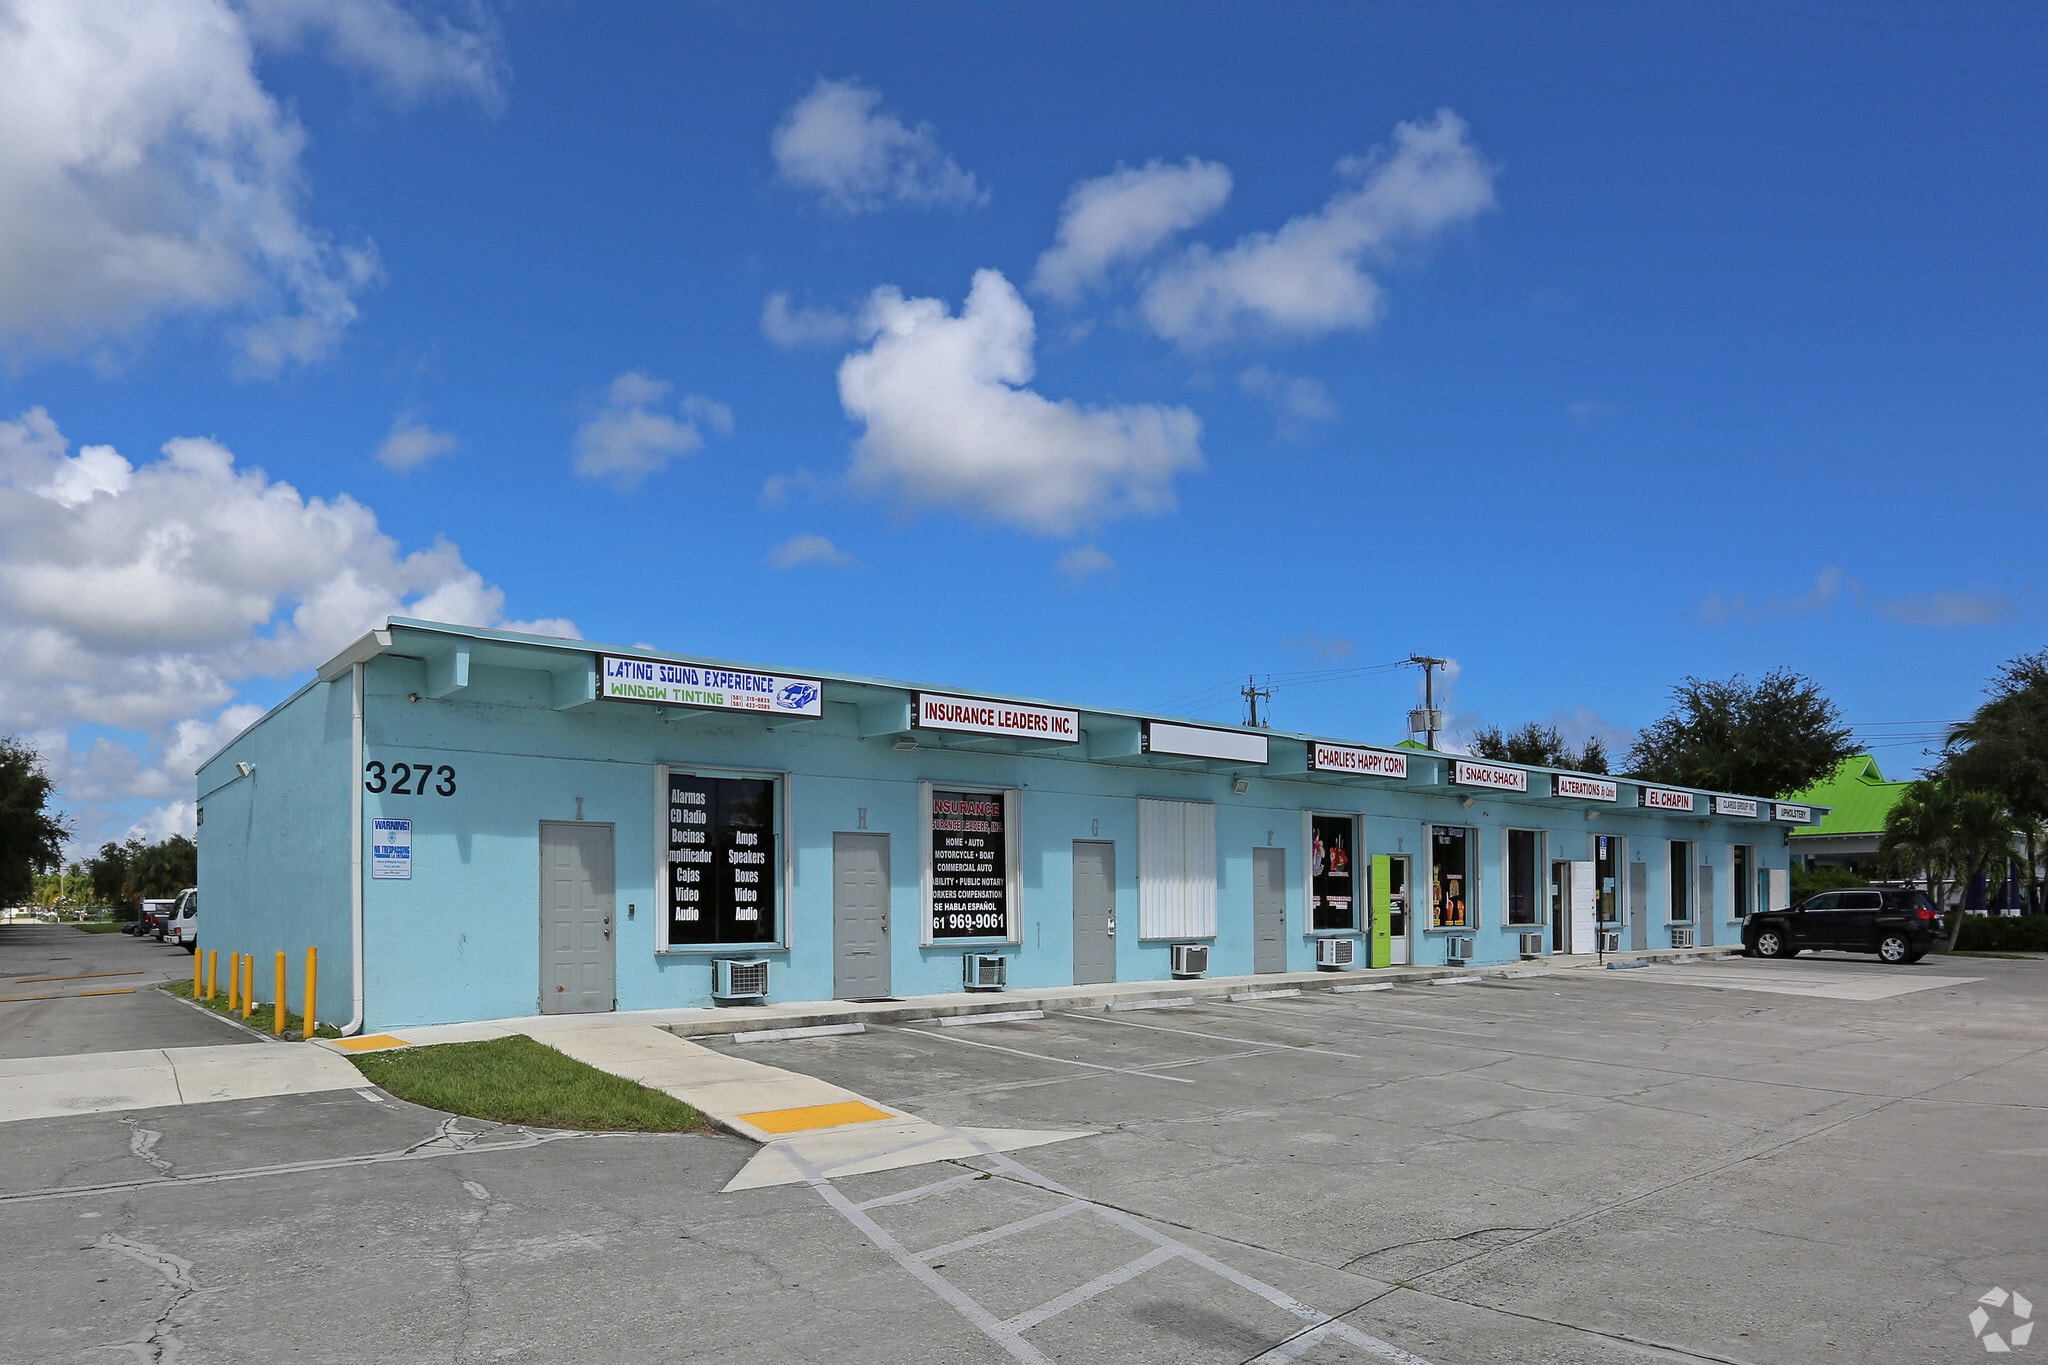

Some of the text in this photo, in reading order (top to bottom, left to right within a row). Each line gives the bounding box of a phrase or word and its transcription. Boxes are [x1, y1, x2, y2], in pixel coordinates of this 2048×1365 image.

[607, 659, 774, 693] LATINO SOUND EXPERIENCE
[611, 682, 667, 700] WINDOW
[673, 688, 724, 706] TINTING
[925, 702, 1073, 735] INSURANCE LEADERS INC.
[1317, 748, 1405, 774] CHARLIE'S HAPPY CORN
[365, 760, 457, 797] 3273
[1466, 767, 1519, 787] SNACK SHACK
[1560, 780, 1600, 796] ALTERATIONS
[671, 788, 706, 805] Alarmas
[1650, 791, 1689, 809] EL CHAPIN
[934, 799, 1000, 816] NSURANCE
[1781, 808, 1807, 820] UPHOLSTERY
[670, 808, 707, 825] CD Radio
[857, 807, 868, 830] H
[374, 820, 410, 831] WARNING!
[932, 819, 961, 831] SURANCE
[671, 828, 706, 844] Bocinas
[735, 830, 758, 847] Amps
[945, 837, 985, 847] HOME AUTO
[374, 845, 410, 855] NO TRESPASSING
[669, 848, 712, 864] mplificador
[728, 849, 765, 865] Speakers
[934, 850, 995, 860] MOTORCYCLE BOAT
[676, 867, 700, 883] Cajas
[734, 868, 759, 883] Boxes
[937, 863, 993, 873] COMMERCIAL AUTO
[959, 877, 981, 886] PUBLIC
[981, 877, 1004, 886] NOTARY
[675, 887, 699, 902] Video
[734, 887, 758, 902] Video
[932, 890, 1003, 899] ORKERS COMPENSATION
[675, 906, 699, 921] Audio
[735, 906, 758, 921] Audio
[934, 900, 997, 911] SE HABLA ESPAÑOL
[933, 913, 1004, 929] 61 969-9061
